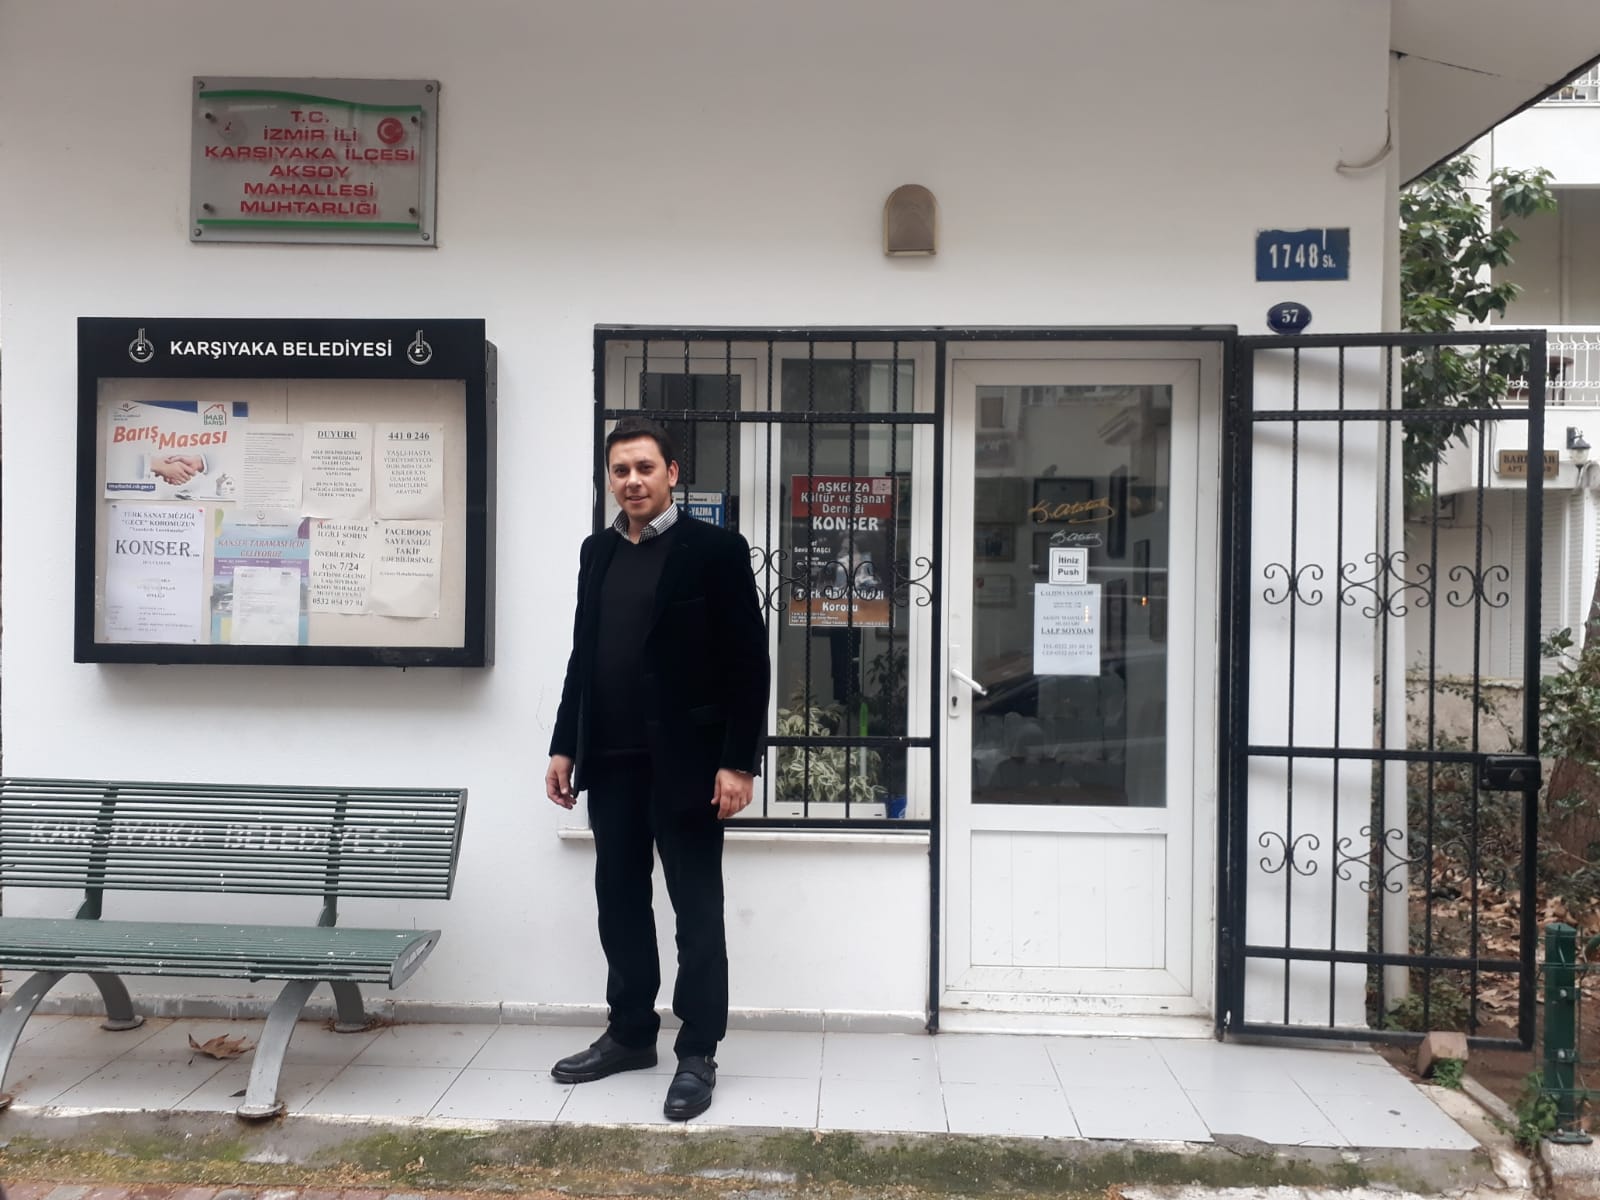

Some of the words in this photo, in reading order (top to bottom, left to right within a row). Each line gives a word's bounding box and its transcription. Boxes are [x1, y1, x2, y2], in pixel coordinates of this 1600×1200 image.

[291, 110, 330, 124] T.C.
[263, 126, 325, 142] İZMİR
[334, 126, 357, 142] İLİ
[269, 165, 350, 179] AKSOY
[243, 182, 375, 198] MAHALLESİ
[240, 200, 377, 216] MUHTARLIĞI
[1269, 243, 1319, 269] 1748
[1322, 254, 1337, 269] Sk.
[1281, 309, 1299, 324] 57
[169, 340, 278, 360] KARŞIYAKA
[282, 339, 393, 358] BELEDİYESİ
[112, 425, 159, 444] Barış
[159, 430, 228, 450] Masası
[317, 430, 357, 440] DUYURU
[388, 431, 404, 440] 441
[406, 431, 412, 440] 0
[415, 431, 430, 440] 246
[854, 493, 887, 504] Sanat
[822, 503, 864, 514] Dernği
[812, 516, 880, 531] KONSER
[385, 527, 432, 537] FACEBOOK
[384, 537, 431, 547] SAYFAMIZI
[115, 539, 190, 557] KONSER
[396, 546, 421, 555] TAKİP
[1058, 555, 1080, 566] İtiniz
[339, 562, 360, 572] 7/24
[1057, 567, 1080, 577] Push
[796, 588, 821, 599] Trk
[822, 601, 859, 612] Korou
